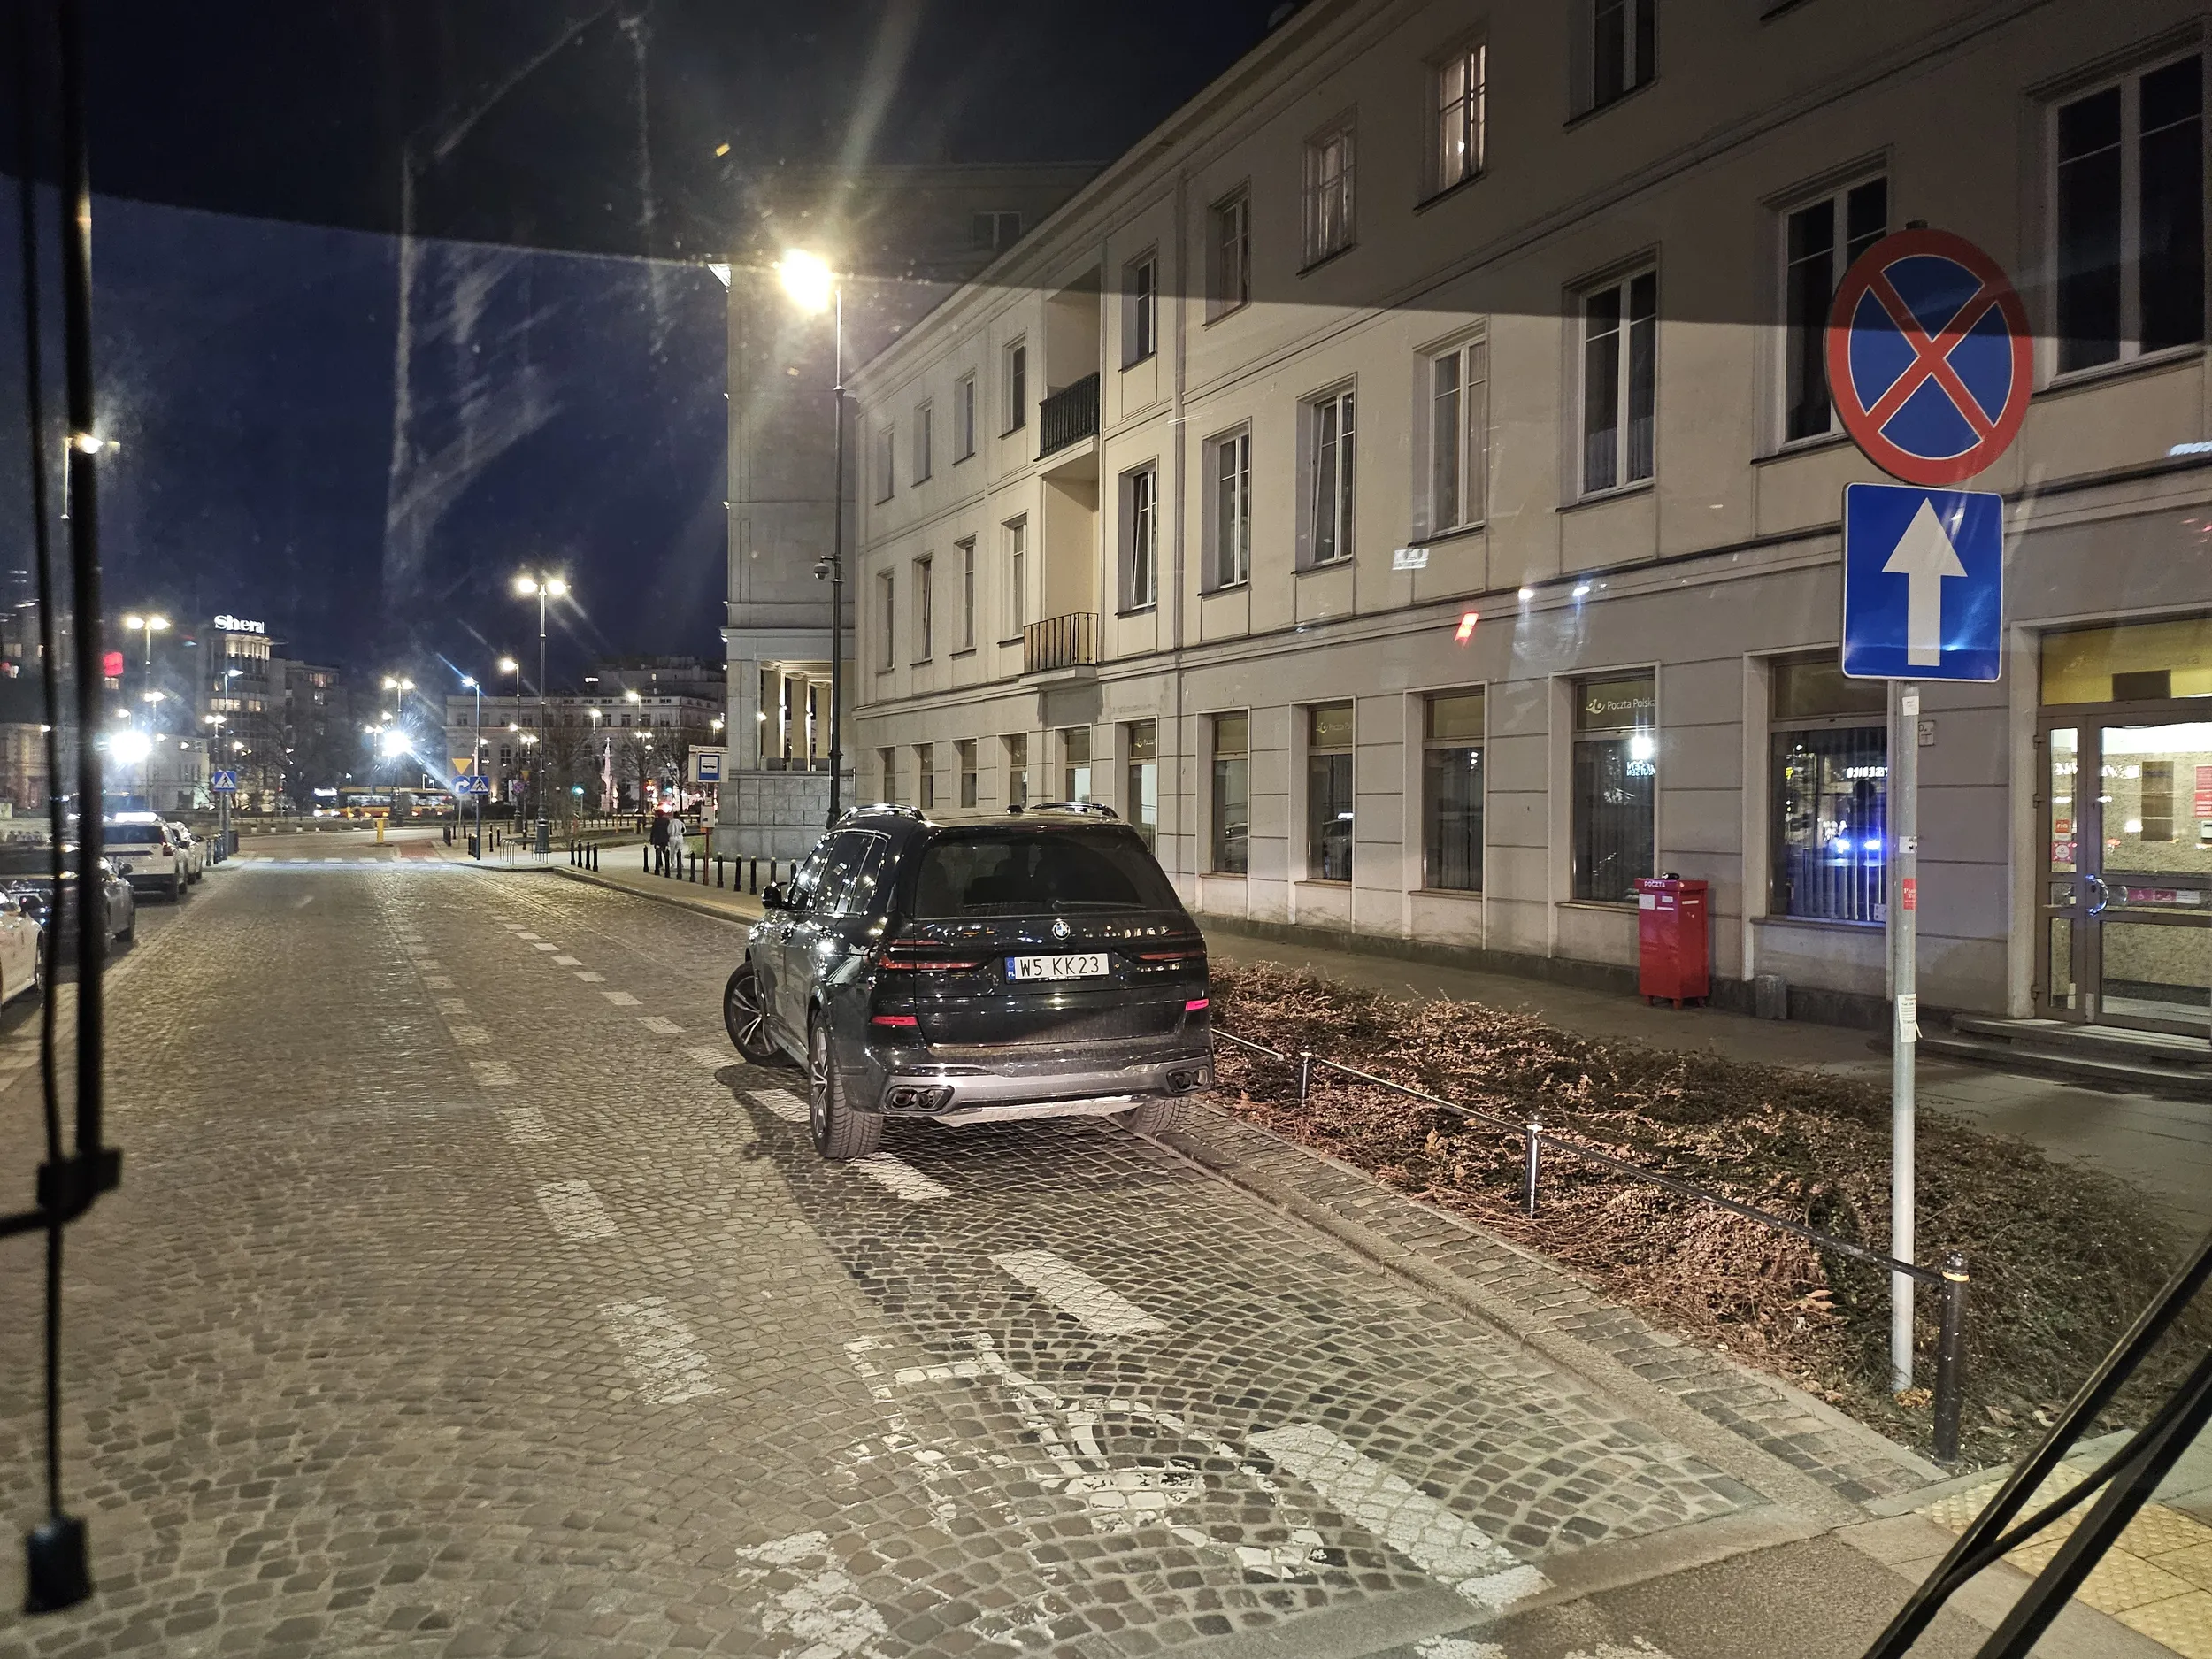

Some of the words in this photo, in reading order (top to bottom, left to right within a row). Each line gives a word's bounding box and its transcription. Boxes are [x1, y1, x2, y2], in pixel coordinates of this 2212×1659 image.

[1607, 700, 1632, 710] Poczta
[1632, 696, 1656, 708] Polska
[1020, 958, 1042, 977] W5
[1052, 956, 1100, 975] KK23
